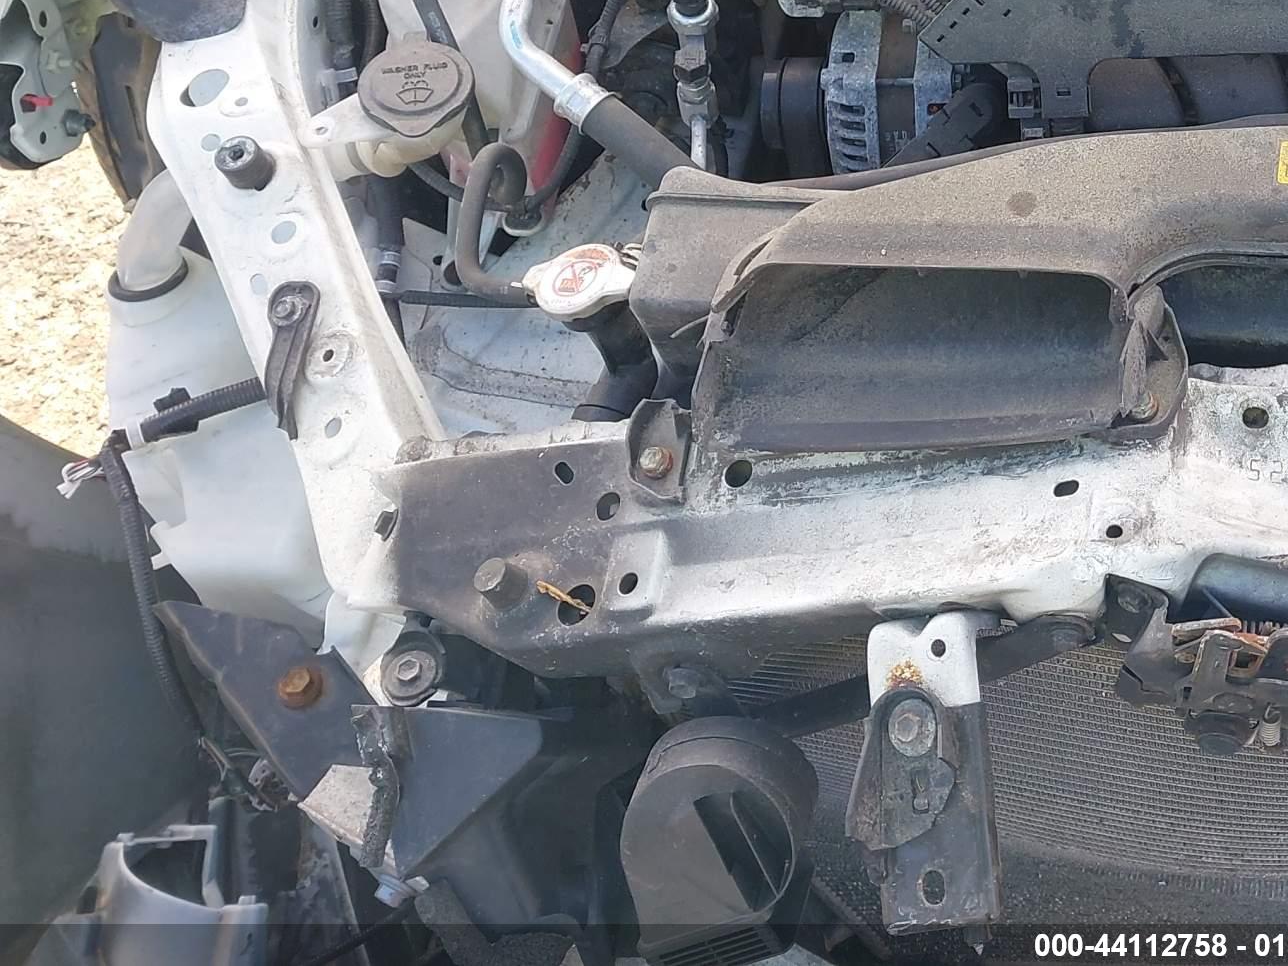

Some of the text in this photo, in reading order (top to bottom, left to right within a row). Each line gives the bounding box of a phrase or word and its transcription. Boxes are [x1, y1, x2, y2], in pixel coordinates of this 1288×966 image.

[381, 61, 449, 75] WASHER FLUID
[403, 70, 427, 80] ONLY
